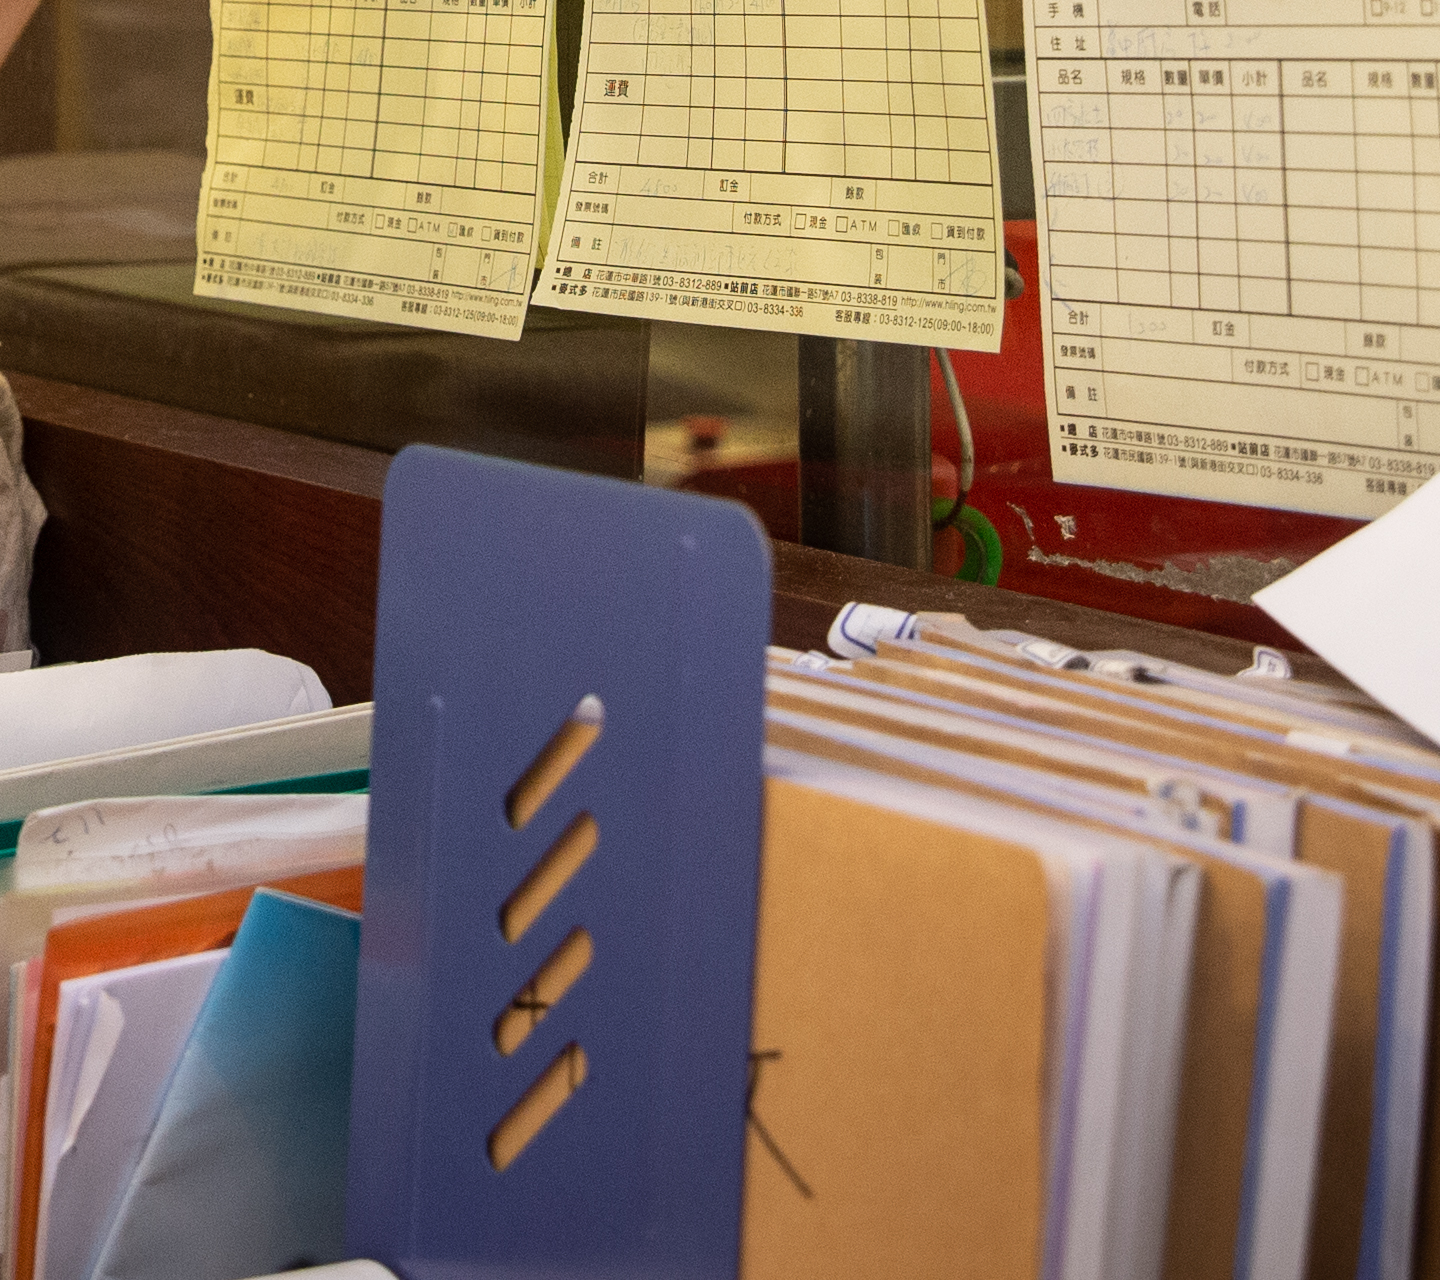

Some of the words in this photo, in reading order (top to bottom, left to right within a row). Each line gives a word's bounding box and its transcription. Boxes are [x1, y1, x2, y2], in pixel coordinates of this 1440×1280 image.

[1058, 70, 1082, 85] 品名
[604, 79, 628, 98] 運費
[587, 171, 608, 185] 合計
[719, 179, 739, 193] 訂金
[844, 185, 864, 201] 餘款
[575, 201, 610, 216] 發票號碼
[743, 212, 781, 227] 付款方式
[809, 216, 827, 229] 現金
[494, 229, 524, 244] 貨到付款
[901, 221, 920, 237] 匯款
[946, 225, 985, 241] 貨到付款
[558, 283, 588, 296] 麥式多
[729, 281, 758, 295] 站前店
[841, 290, 898, 306] 03-8338-819
[1244, 360, 1289, 375] 付款方式
